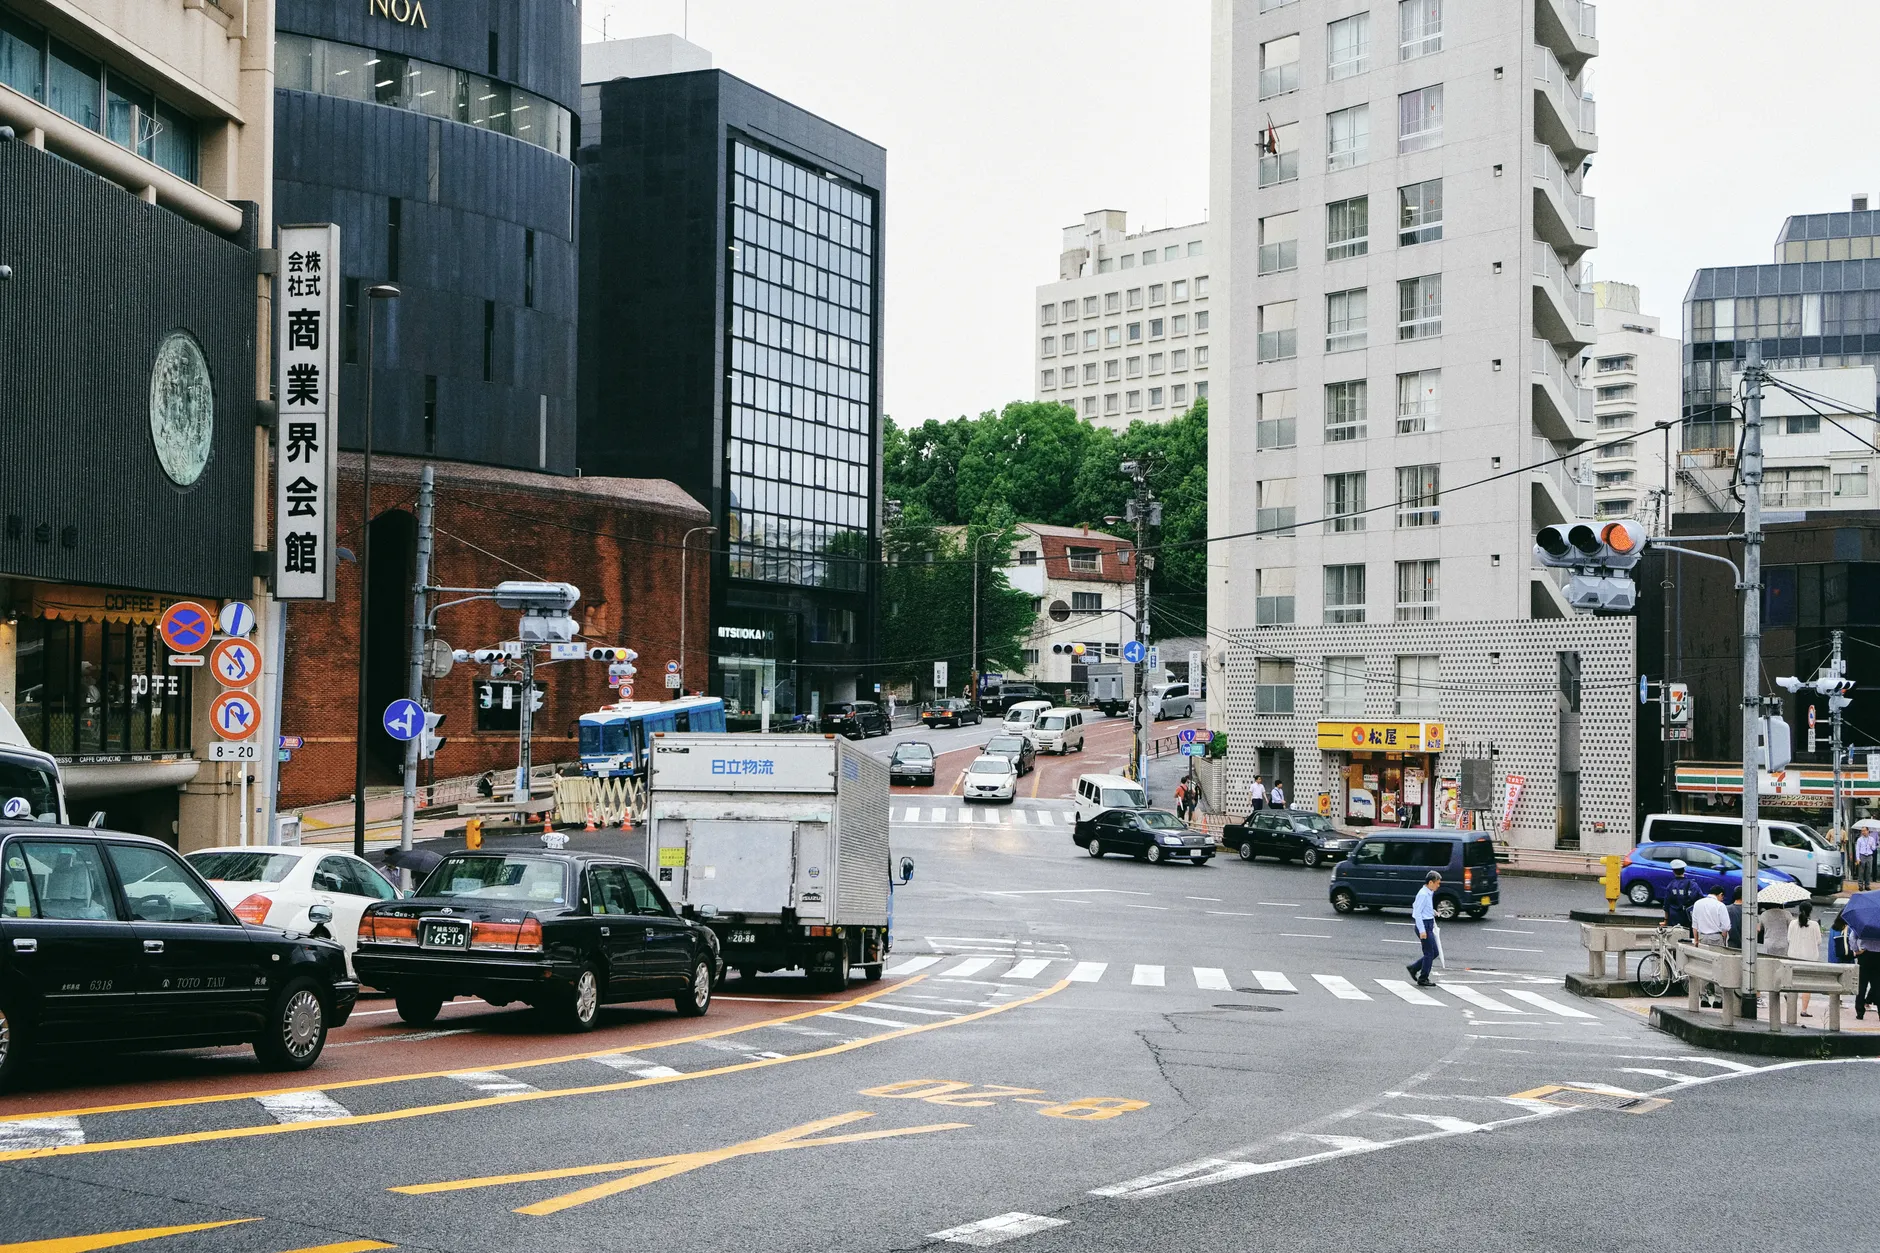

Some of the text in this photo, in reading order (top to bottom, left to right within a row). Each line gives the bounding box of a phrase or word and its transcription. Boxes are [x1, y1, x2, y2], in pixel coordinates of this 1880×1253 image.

[370, 0, 428, 28] NOA
[285, 308, 321, 574] 商業界会館
[105, 594, 155, 613] COFFEE
[1369, 728, 1397, 745] 松屋
[216, 746, 254, 758] 8-20
[712, 759, 774, 775] 日立物流
[434, 932, 465, 945] 65-19
[732, 934, 756, 943] 20-88
[90, 979, 113, 991] 6318
[177, 977, 201, 988] TOTO
